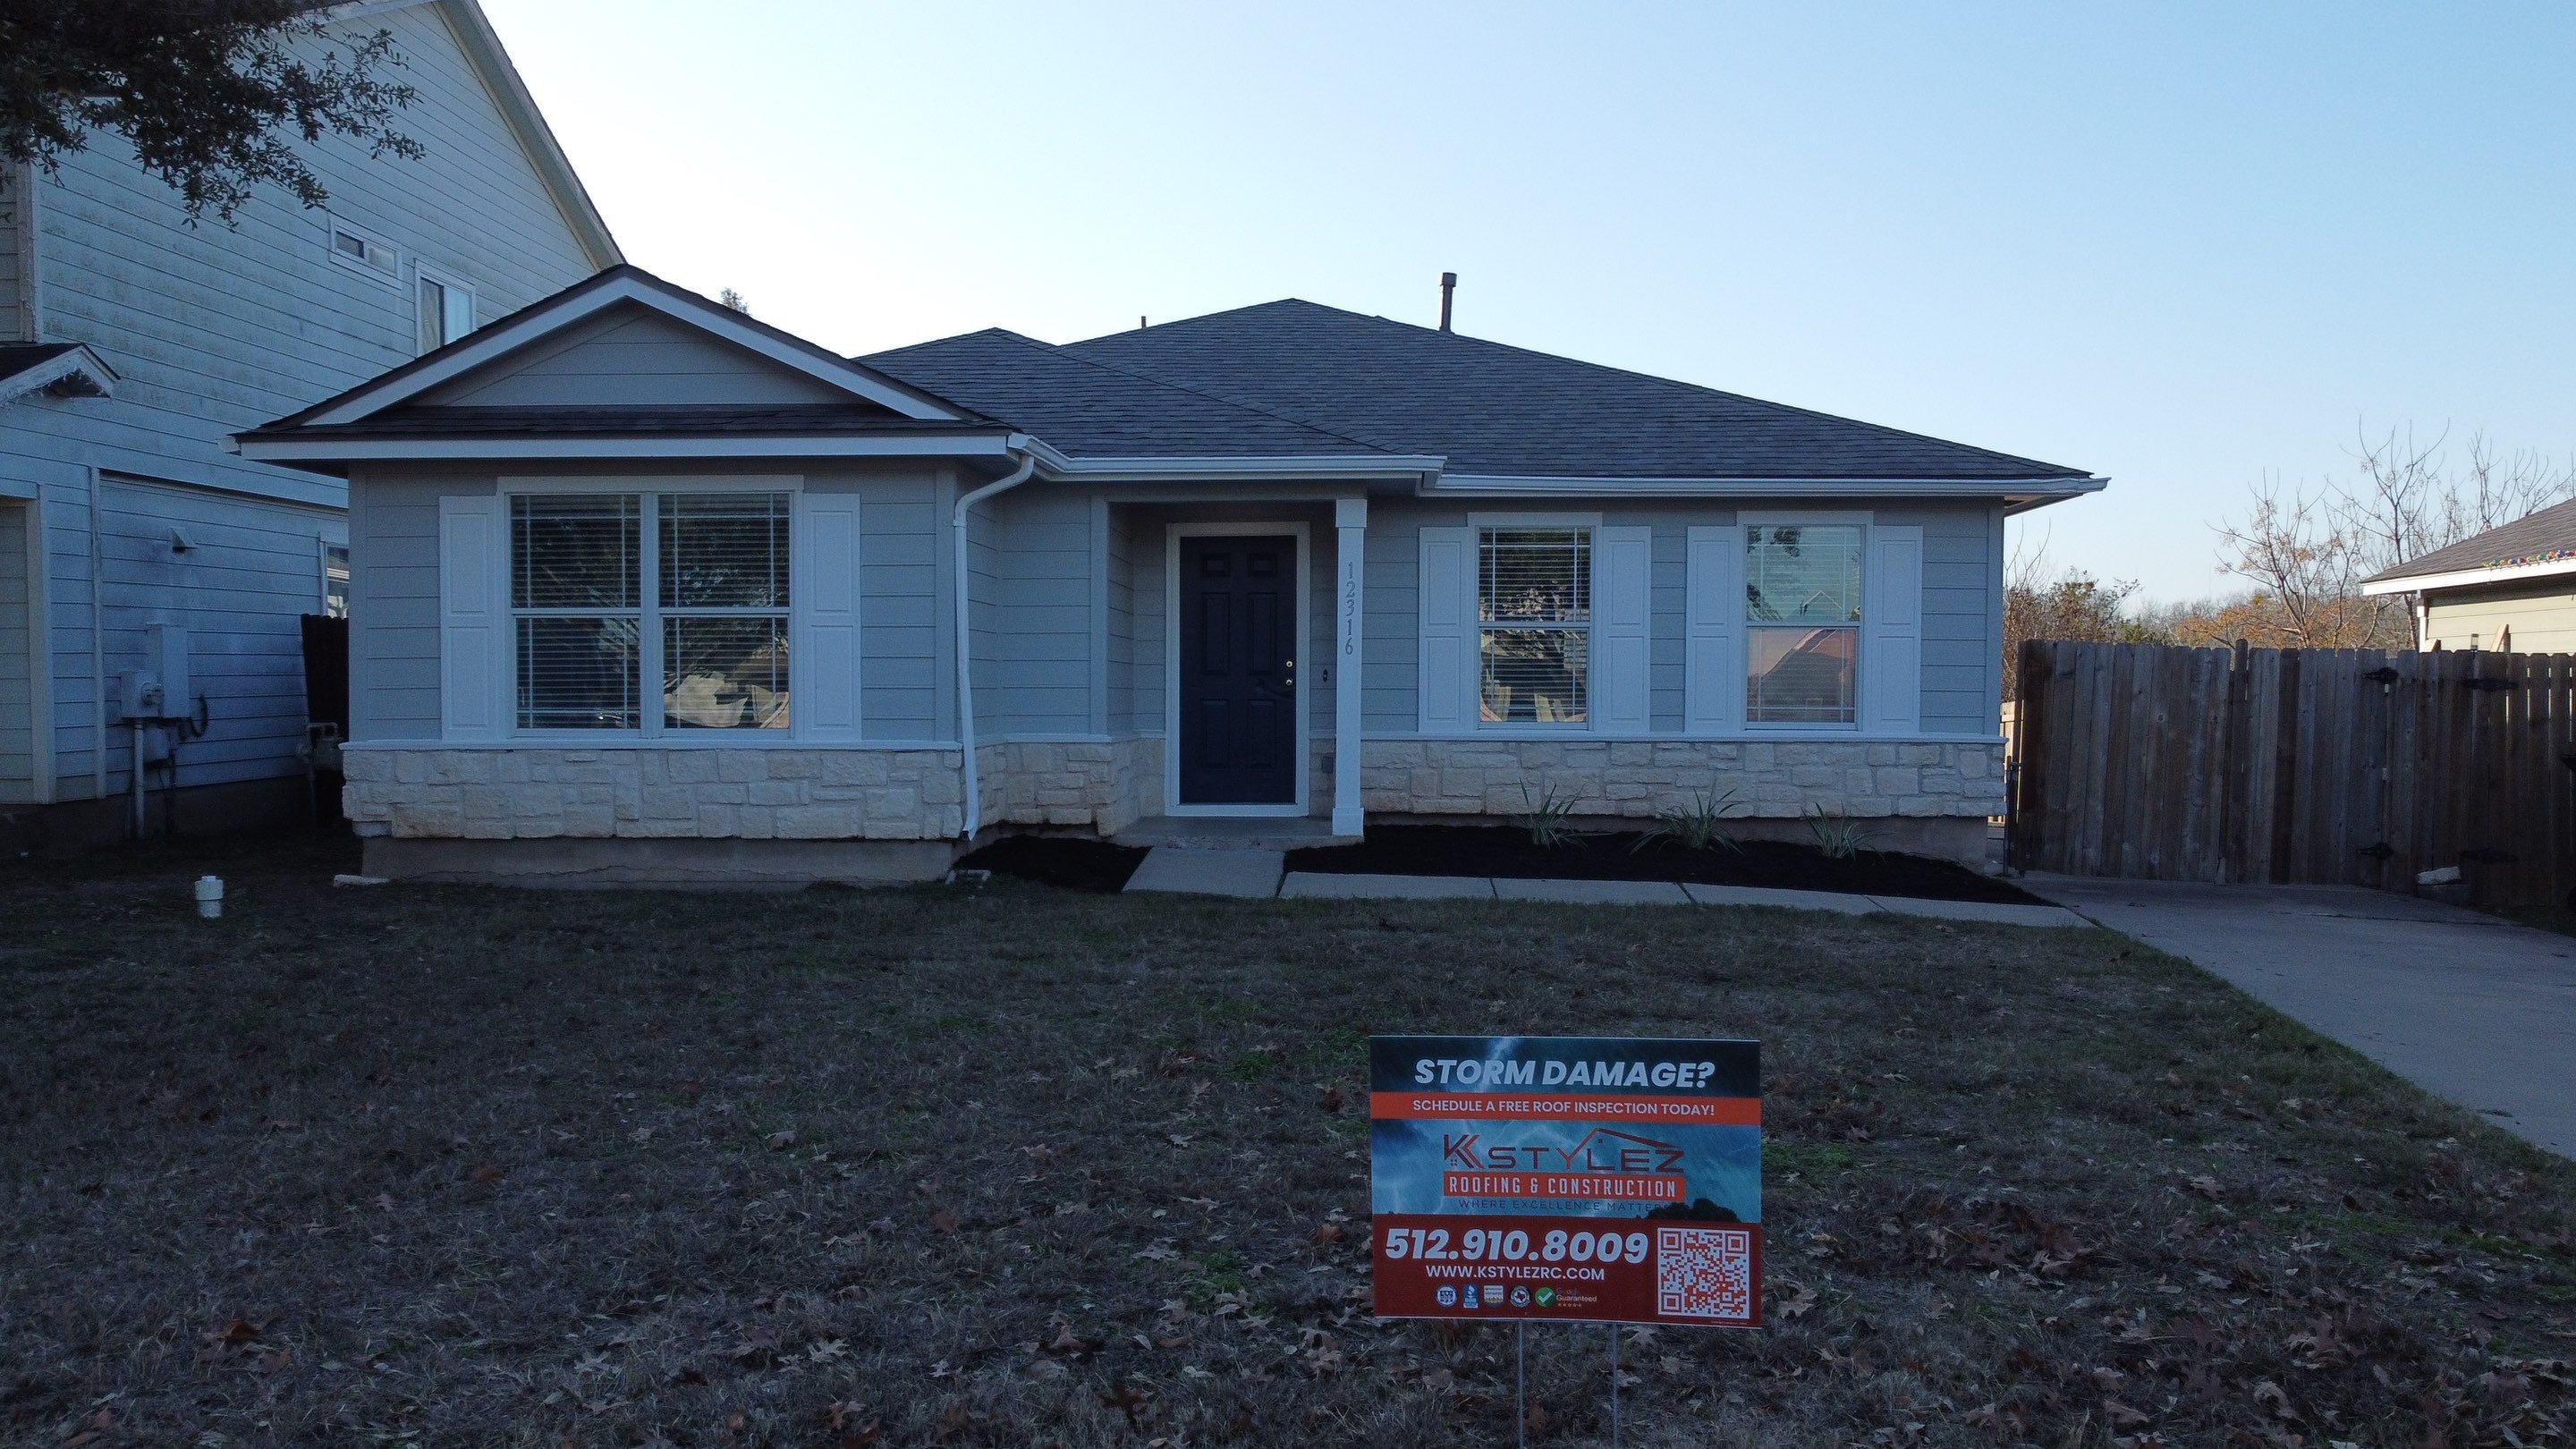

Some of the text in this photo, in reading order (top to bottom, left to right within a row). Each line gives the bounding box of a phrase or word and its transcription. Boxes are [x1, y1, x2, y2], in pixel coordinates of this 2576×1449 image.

[1344, 561, 1356, 656] 12316
[1415, 1059, 1716, 1089] STORM DAMAGE?
[1413, 1099, 1715, 1116] SCHEDULE A FREE ROOF INSPECTION TODAY!
[1449, 1175, 1676, 1198] ROOFING & CONSTRUCTION
[1459, 1199, 1506, 1209] WHERE
[1513, 1200, 1601, 1211] EXCELLENCE
[1385, 1227, 1648, 1264] 512.910.8009
[1426, 1265, 1605, 1281] WWW.KSTYLEZRC.COM
